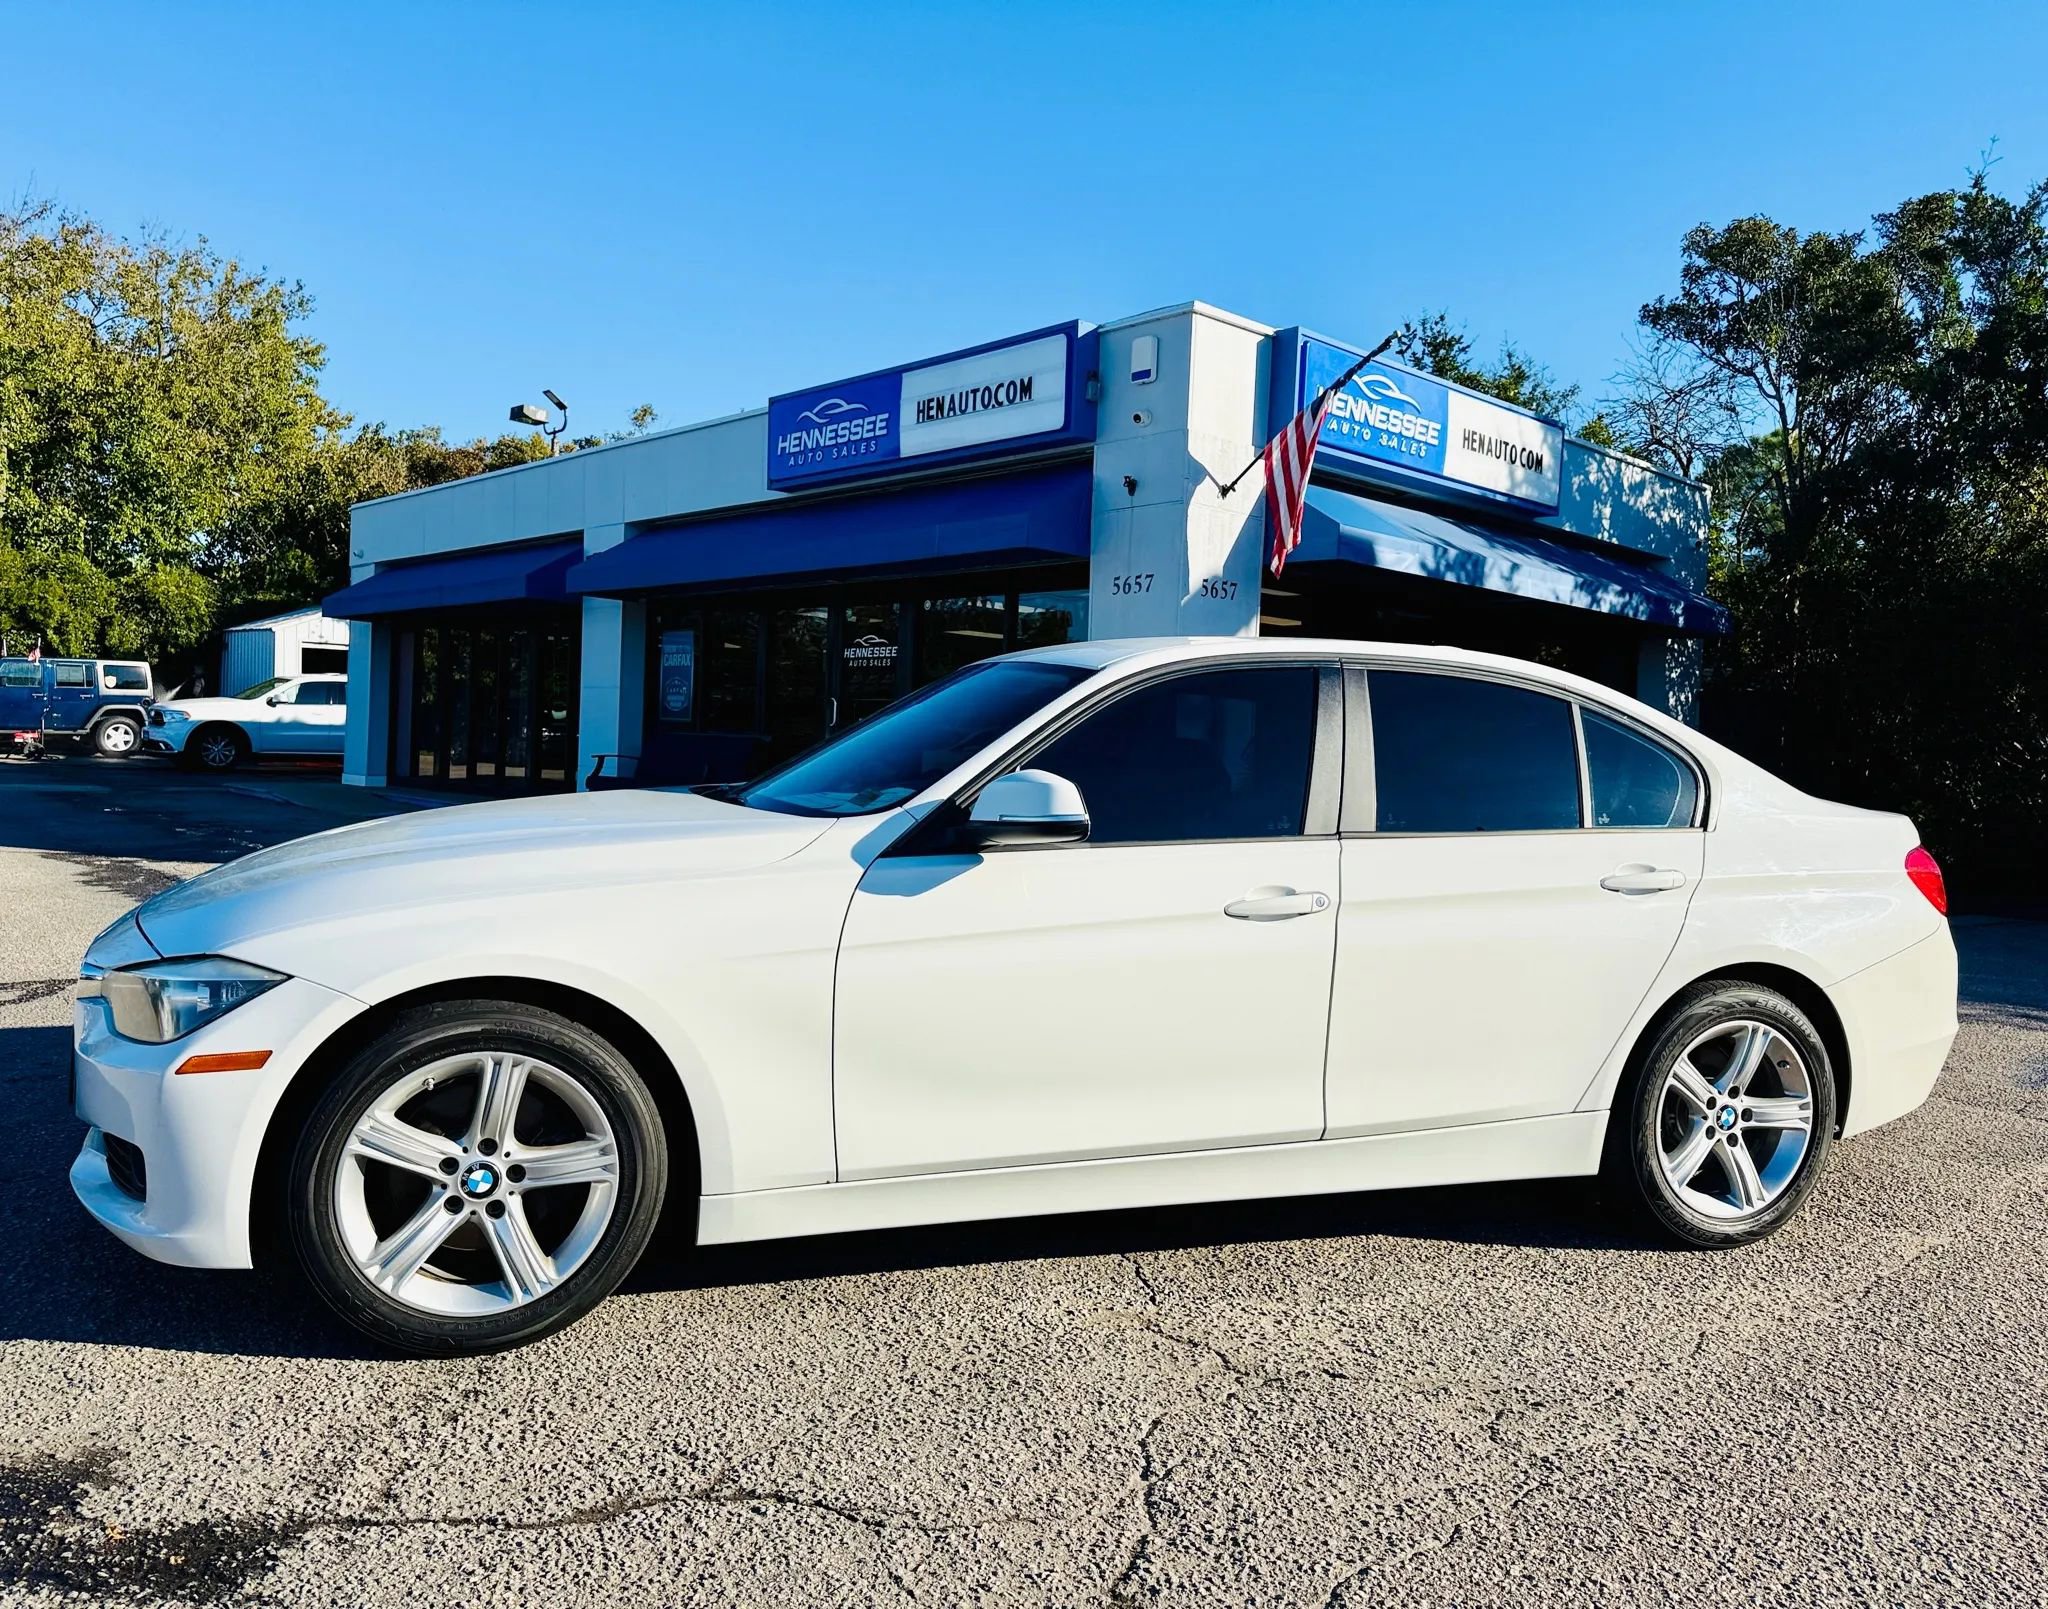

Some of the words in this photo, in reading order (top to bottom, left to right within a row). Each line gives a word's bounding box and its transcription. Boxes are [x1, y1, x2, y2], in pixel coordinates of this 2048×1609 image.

[916, 376, 1034, 424] HENAUTO.COM
[777, 412, 890, 456] HENNESSEE
[1328, 419, 1371, 442] AUTO
[1379, 433, 1428, 458] SALES
[788, 450, 824, 467] AUTO
[832, 439, 878, 458] SALES
[1111, 573, 1155, 596] 5657
[1200, 578, 1238, 600] 5657
[663, 654, 692, 667] CARFAX
[843, 646, 899, 658] HENNESSEE
[848, 659, 868, 667] AUTO
[869, 658, 891, 667] SALES
[1754, 997, 1818, 1043] SENTURY
